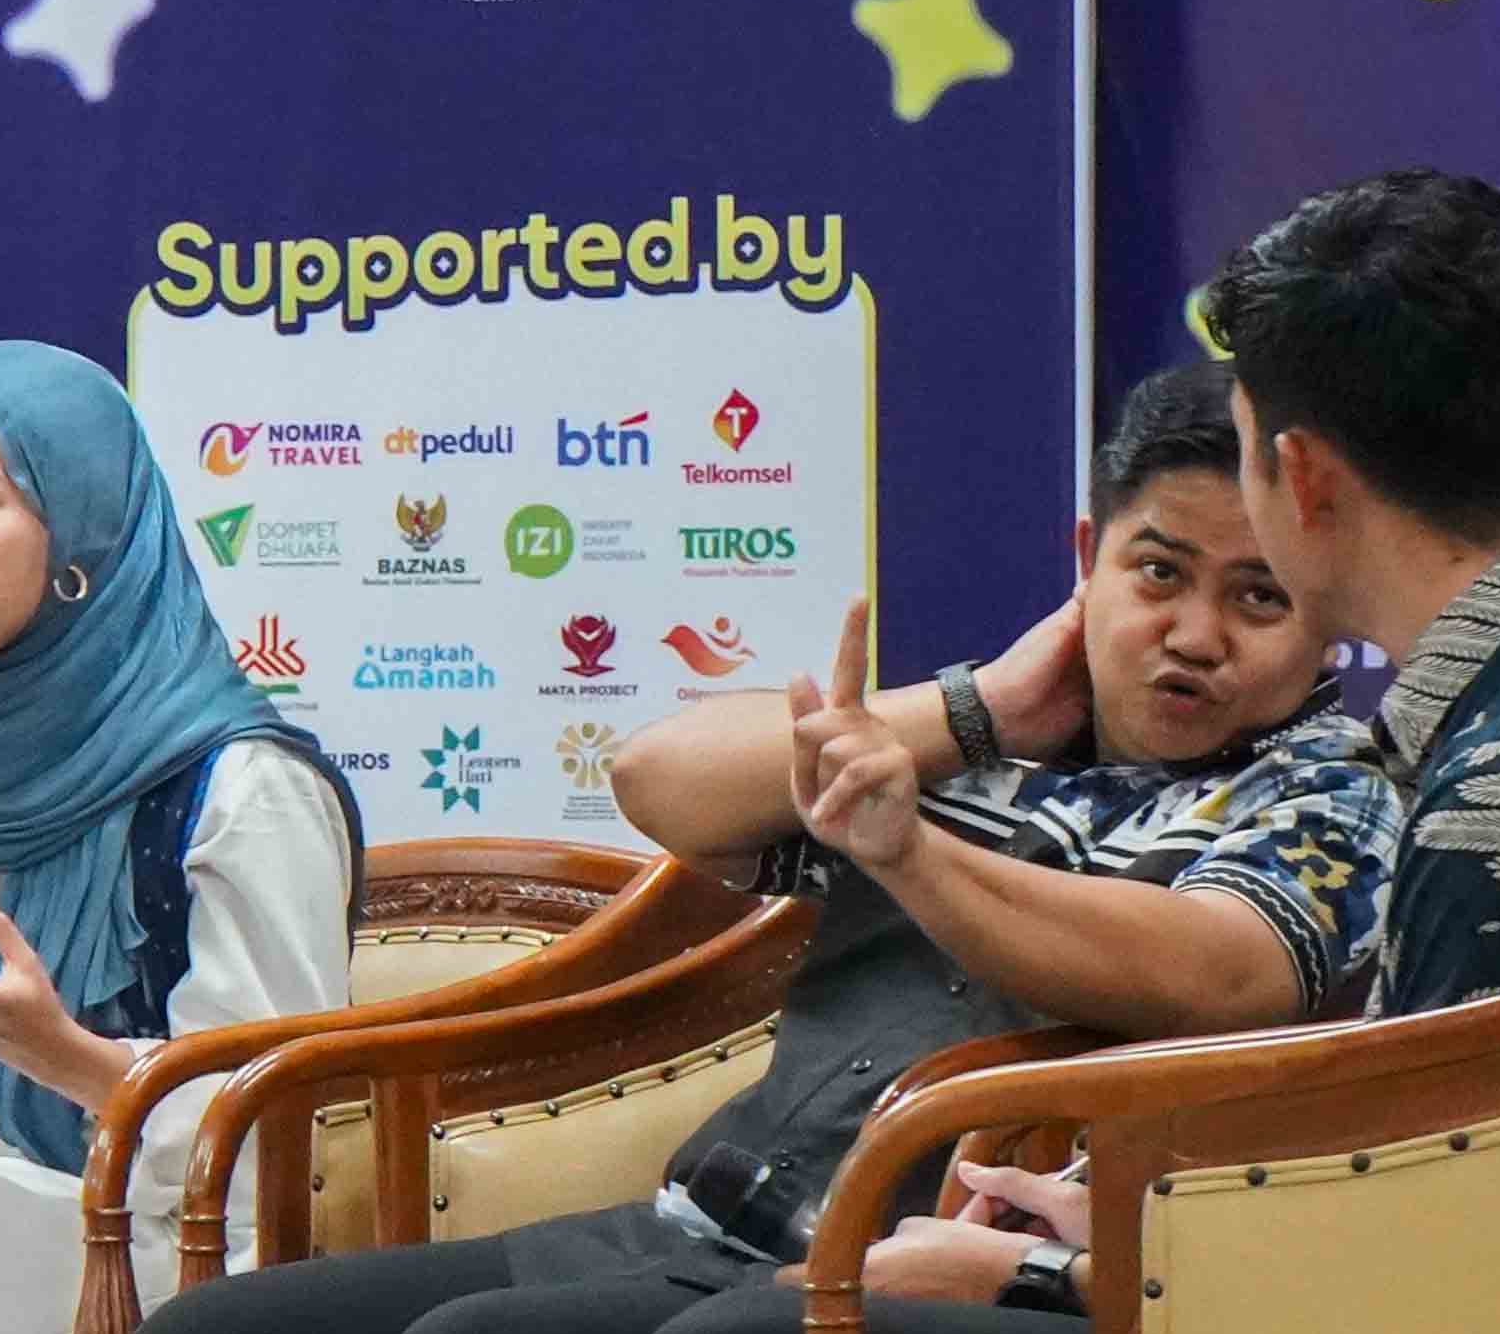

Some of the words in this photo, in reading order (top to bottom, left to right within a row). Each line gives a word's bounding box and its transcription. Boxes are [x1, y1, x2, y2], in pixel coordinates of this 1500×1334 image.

[156, 196, 690, 325] Supported
[716, 194, 843, 303] by
[268, 423, 361, 442] NOMIRA
[269, 447, 362, 465] TRAVEL
[681, 462, 792, 484] Telkomsel
[257, 521, 340, 540] DOMPET
[257, 541, 341, 559] DHUAFA
[515, 526, 564, 556] IZI
[377, 558, 466, 575] BAZNAS
[380, 643, 474, 667] Langkah
[538, 684, 575, 696] MATA
[579, 683, 639, 696] PROJECT
[331, 753, 390, 770] UROS
